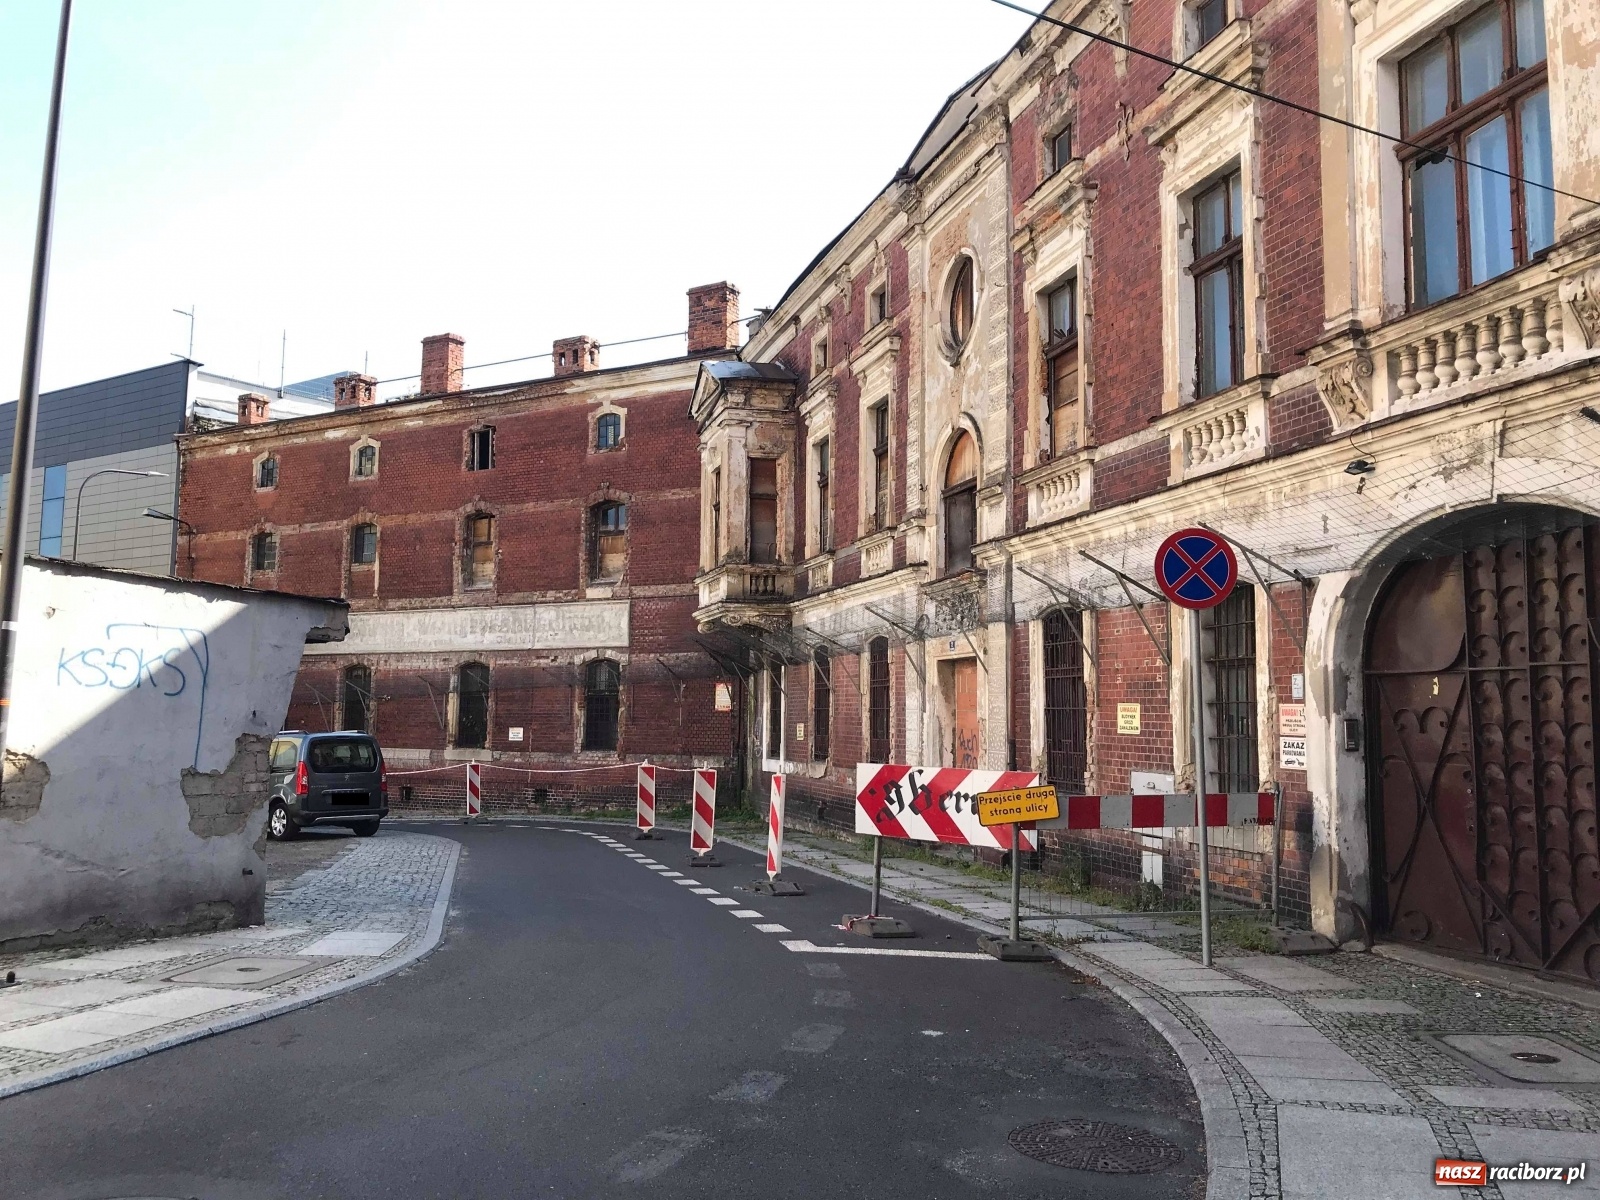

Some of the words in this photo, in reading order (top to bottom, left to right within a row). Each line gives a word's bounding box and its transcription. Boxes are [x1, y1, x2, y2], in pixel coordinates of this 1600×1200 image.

[1283, 741, 1305, 750] ZAKAZ
[1282, 749, 1306, 757] PARKOWANIA
[978, 792, 1022, 805] Przejście
[1025, 802, 1048, 813] ulicy
